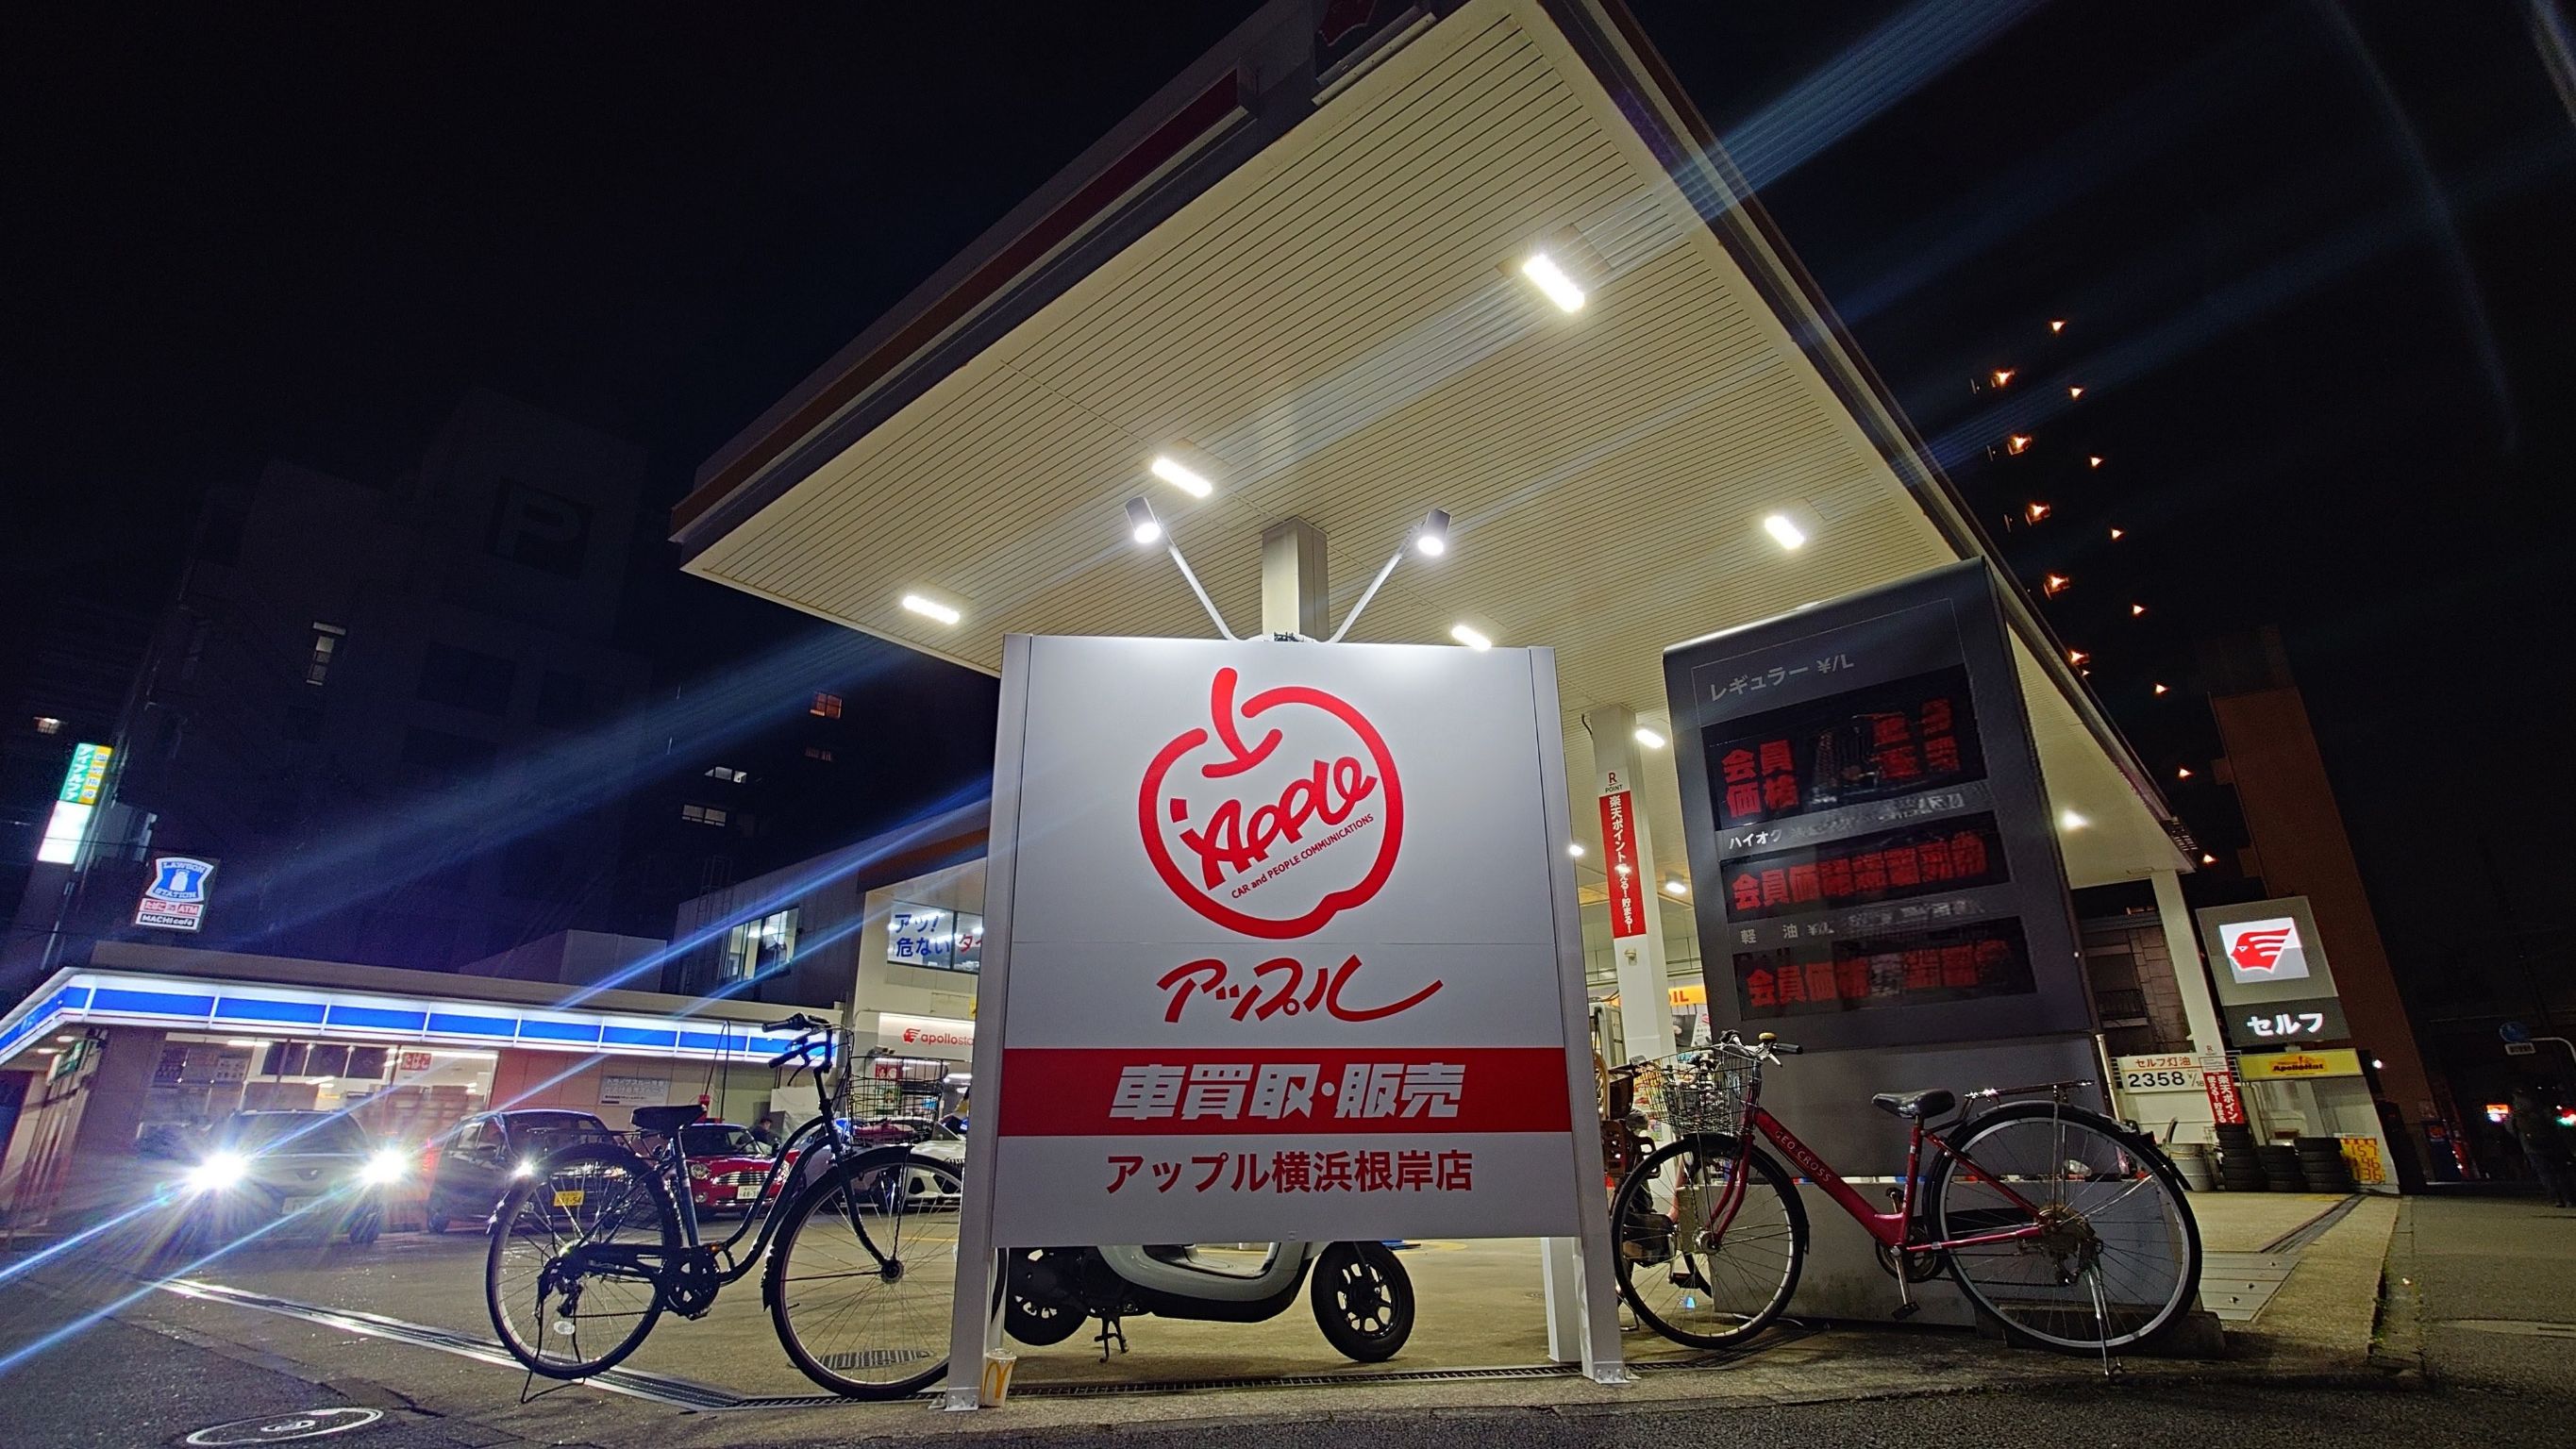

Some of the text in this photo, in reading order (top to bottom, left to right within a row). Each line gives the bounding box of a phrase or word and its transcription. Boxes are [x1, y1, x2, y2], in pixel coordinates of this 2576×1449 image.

[1710, 666, 1809, 701] レギュラー
[1729, 829, 1782, 850] ハイオク
[1231, 813, 1374, 899] CAR and PEOPLE COMMUNICATIONS
[162, 861, 207, 874] LAWSON
[154, 887, 197, 898] STATION
[142, 915, 173, 924] MACHI
[177, 905, 198, 915] ATM
[895, 936, 950, 958] 危ない
[1157, 955, 1444, 1022] アップル
[2247, 1013, 2323, 1037] セルフ
[2135, 1057, 2192, 1068] セルフ灯油
[2128, 1071, 2185, 1088] 2358
[1775, 1130, 1832, 1182] GEO CROSS
[1107, 1150, 1473, 1193] アップル横浜根岸店
